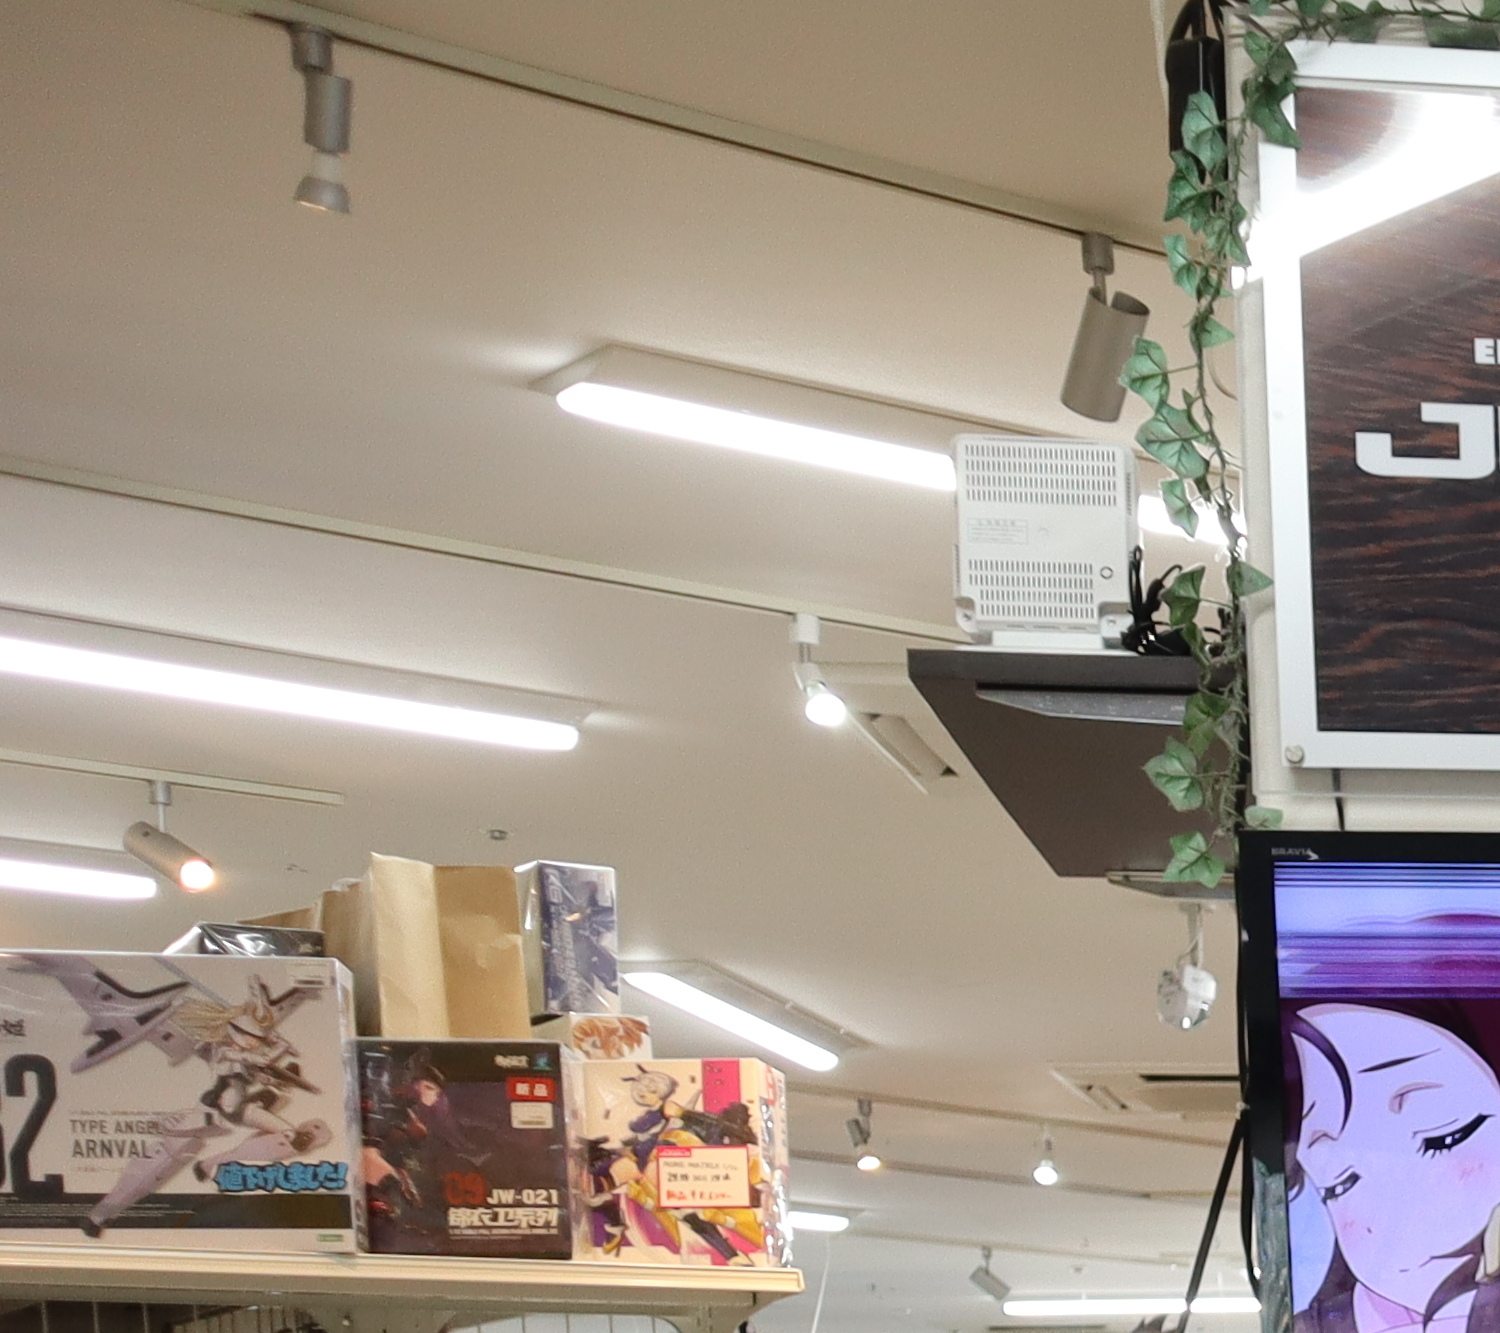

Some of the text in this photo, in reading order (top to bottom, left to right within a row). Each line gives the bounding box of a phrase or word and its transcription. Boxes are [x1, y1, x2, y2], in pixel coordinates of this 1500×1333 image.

[514, 1082, 550, 1098] 新品
[70, 1118, 108, 1136] TYPE
[72, 1138, 154, 1160] ARNVAL
[215, 1160, 348, 1194] 値下げしました!
[486, 1188, 559, 1206] JW-021
